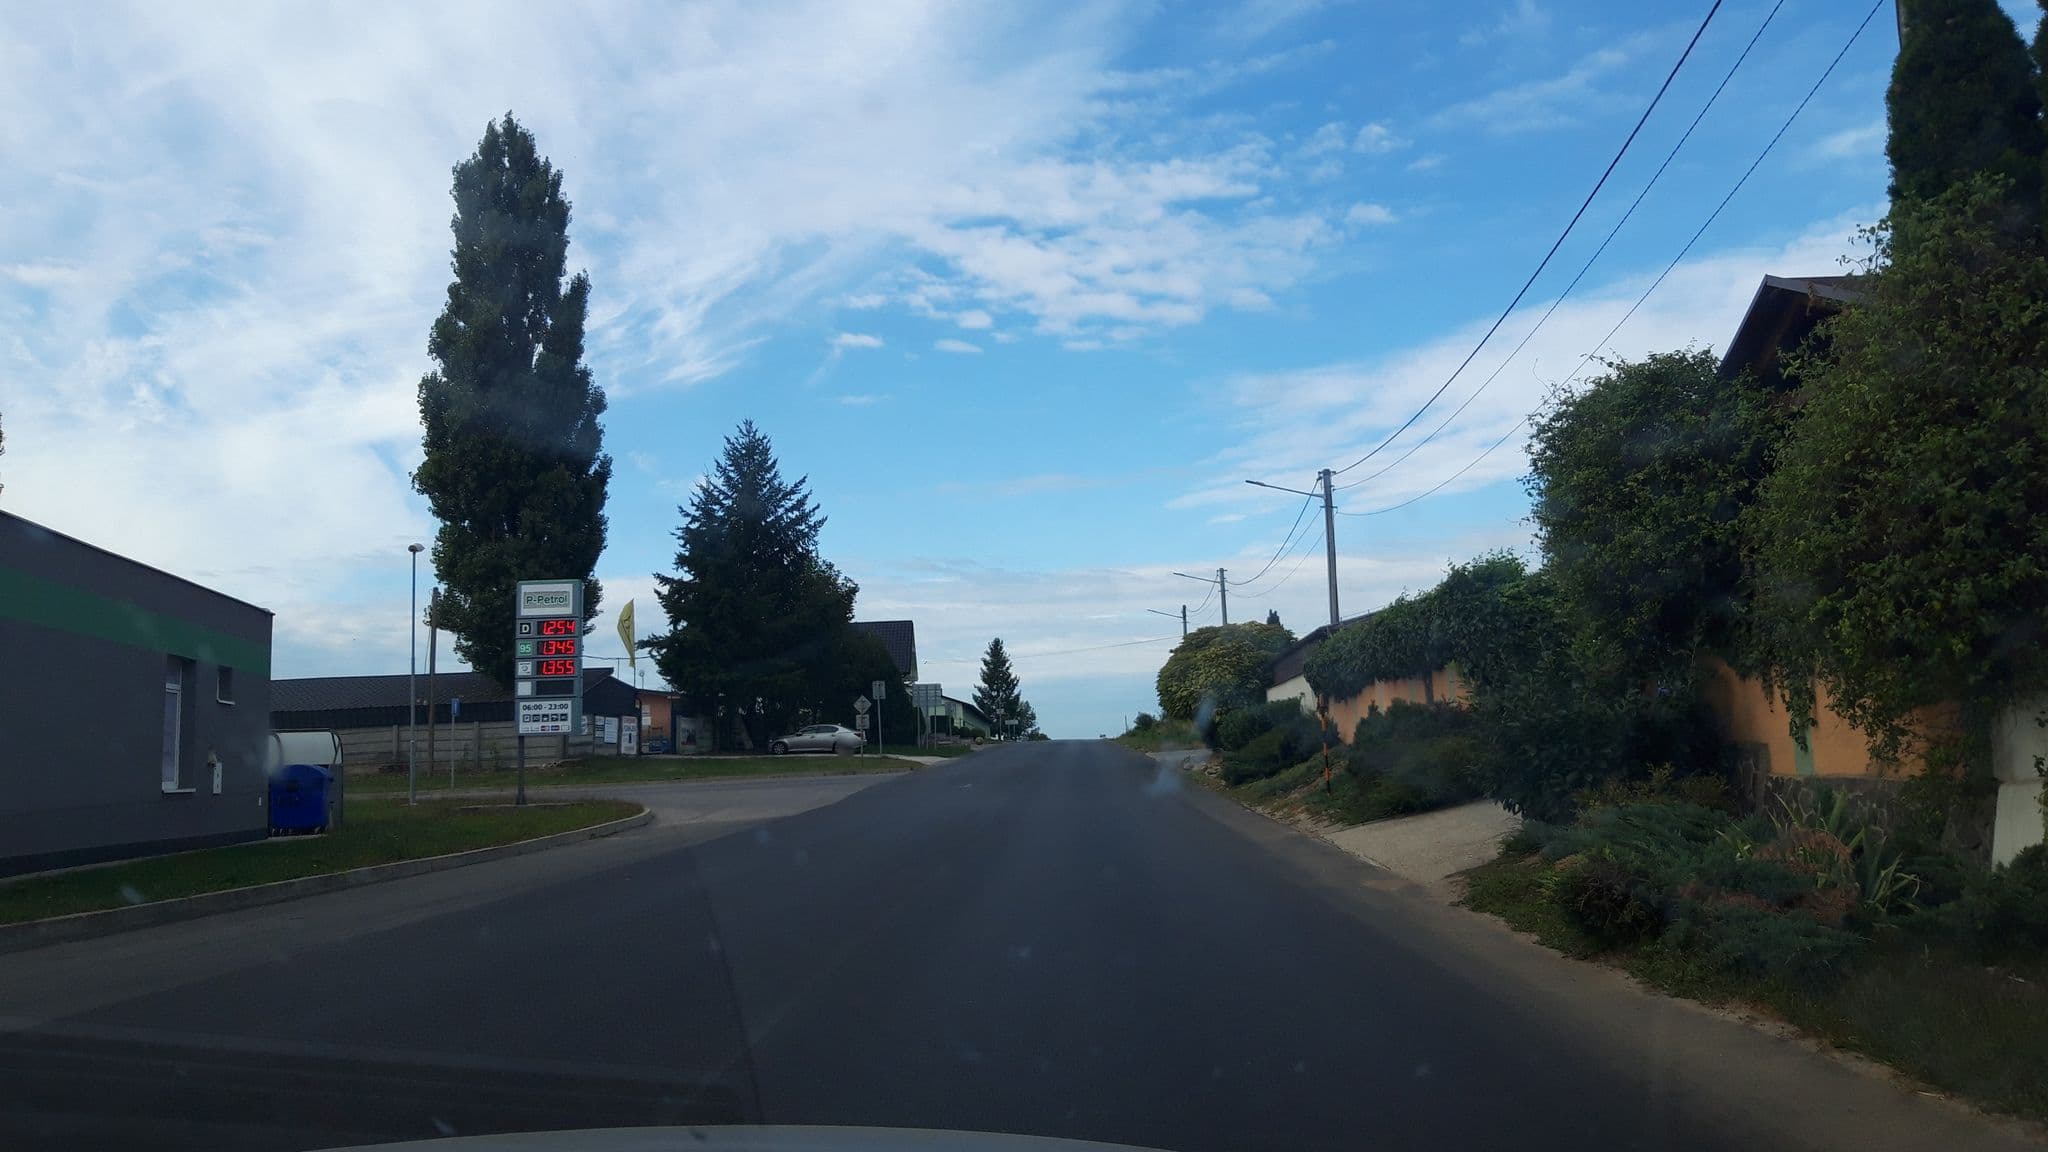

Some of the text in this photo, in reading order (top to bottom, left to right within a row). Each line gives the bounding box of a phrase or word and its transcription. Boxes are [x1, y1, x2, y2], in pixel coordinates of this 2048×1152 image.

[526, 595, 568, 604] P-Petrol
[522, 624, 530, 633] D
[519, 645, 531, 653] 95
